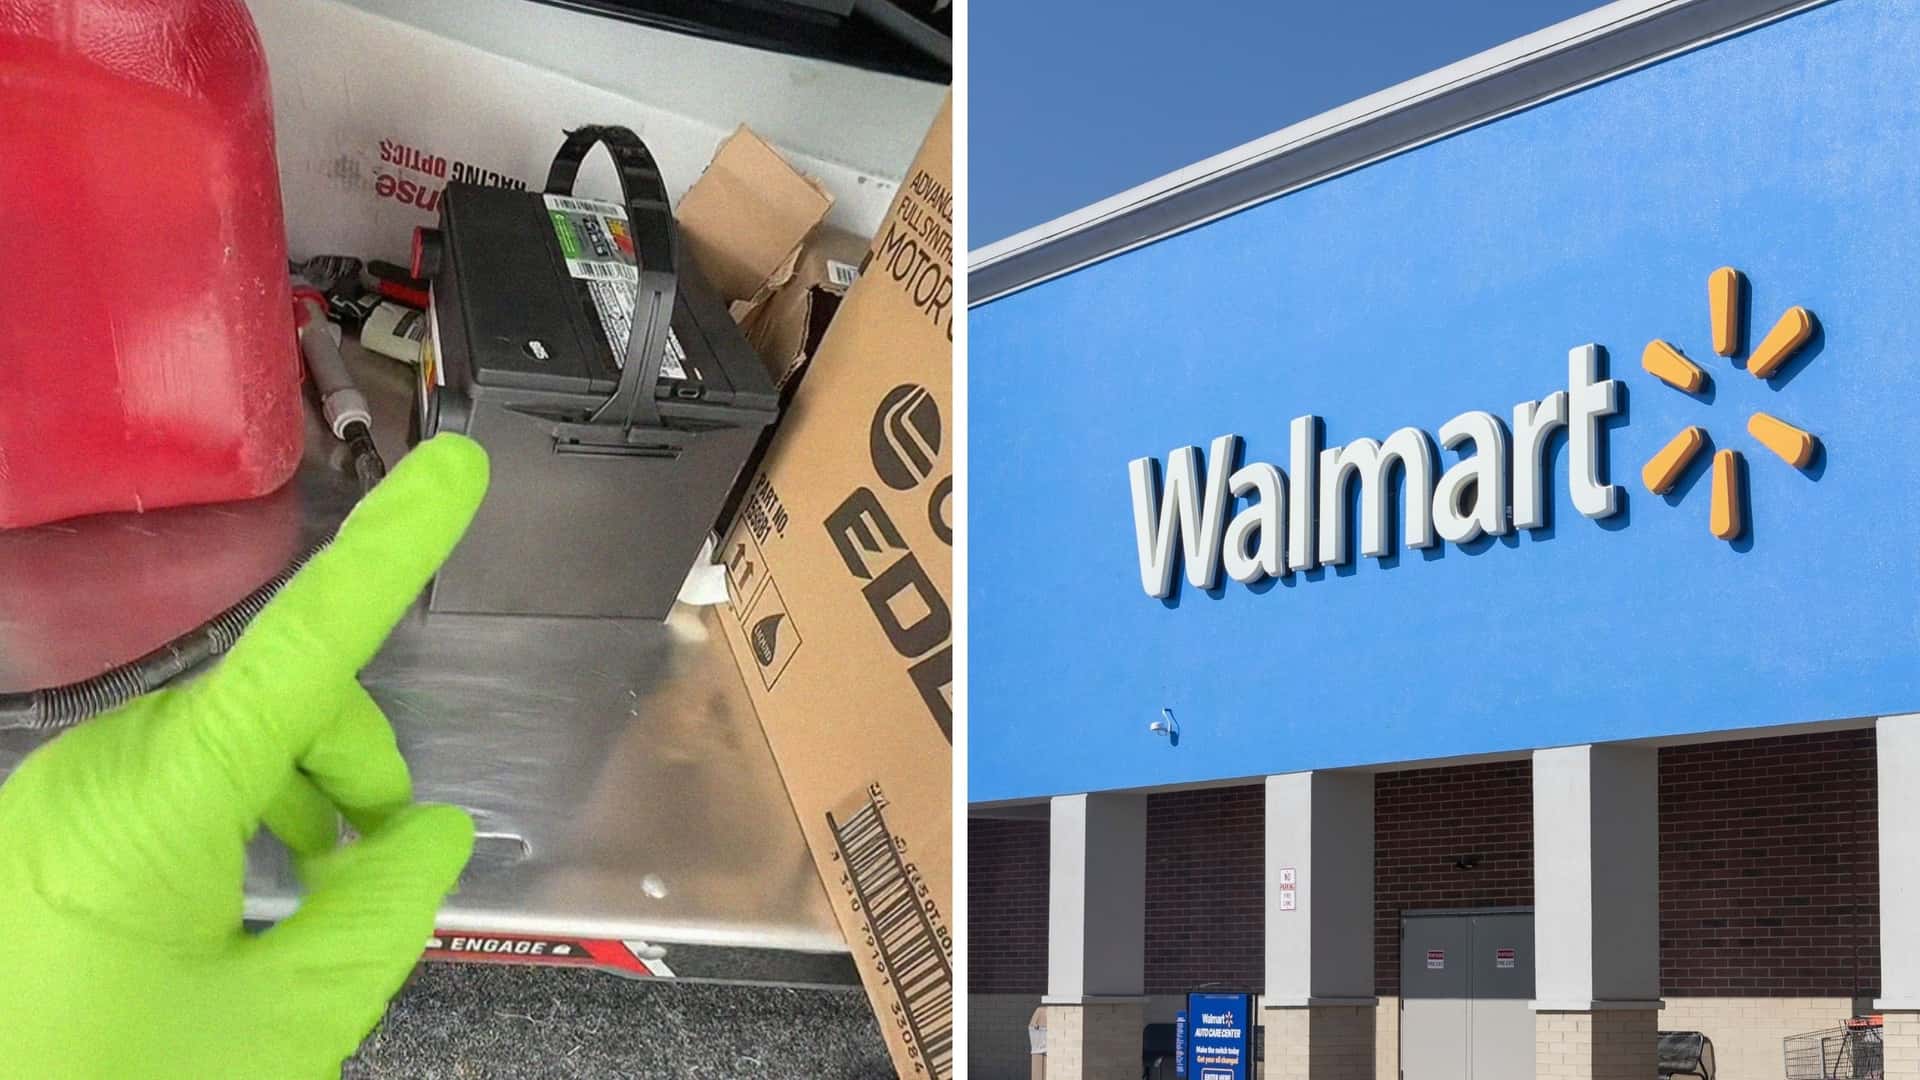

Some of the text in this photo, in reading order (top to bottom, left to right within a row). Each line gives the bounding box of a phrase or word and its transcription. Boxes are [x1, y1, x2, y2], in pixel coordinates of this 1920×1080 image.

[379, 137, 447, 177] OPTICS
[898, 196, 919, 231] FULL
[1128, 343, 1618, 600] Walmart
[756, 472, 778, 508] PART
[450, 937, 547, 955] ENGAGE
[1201, 1013, 1225, 1024] Walmart
